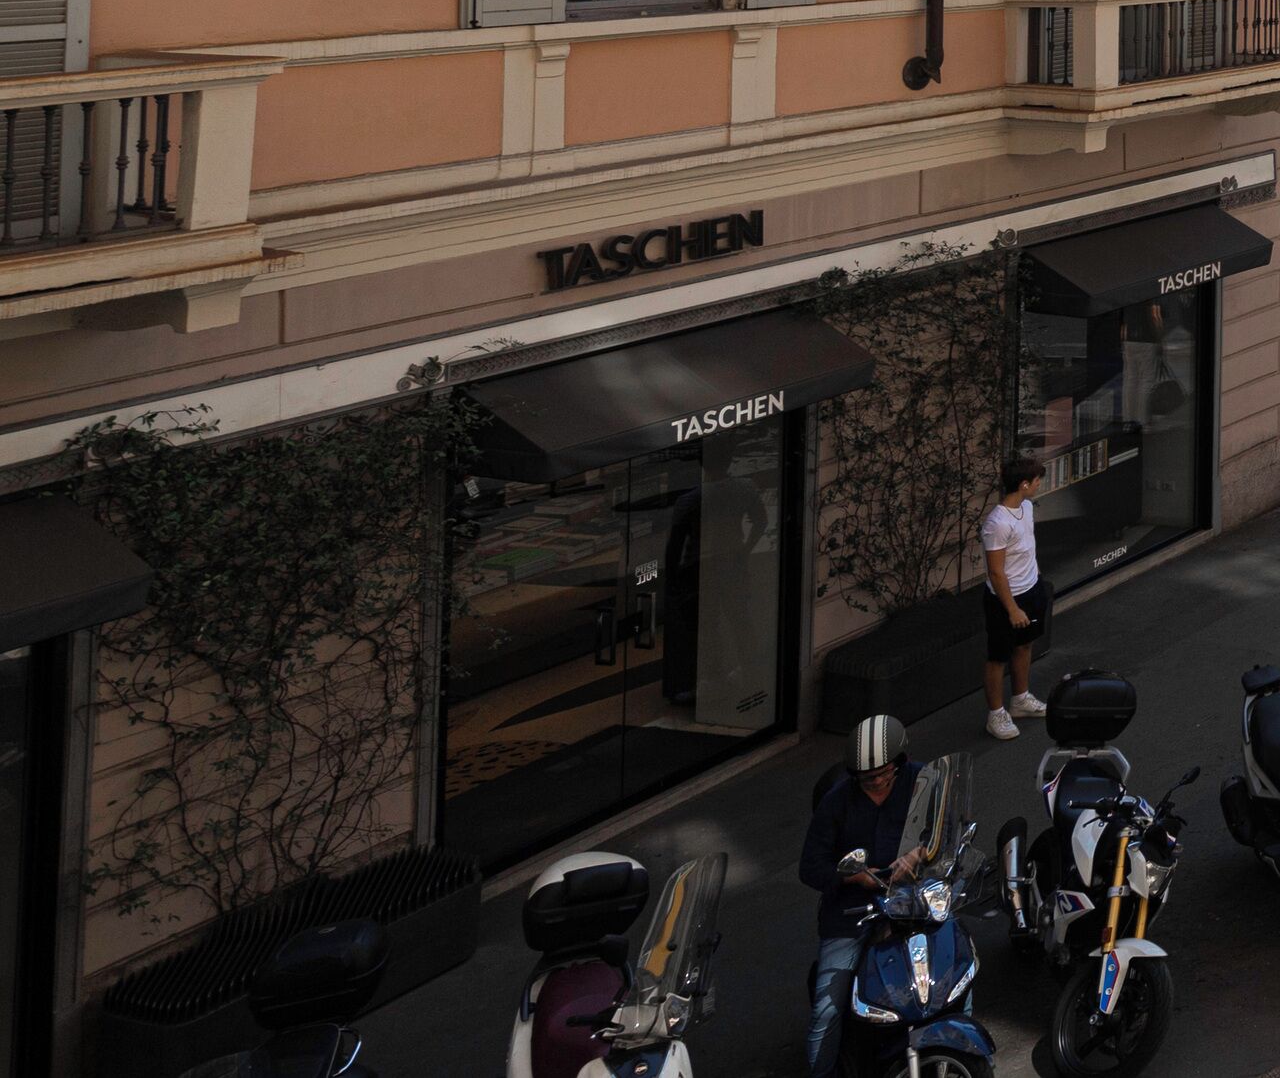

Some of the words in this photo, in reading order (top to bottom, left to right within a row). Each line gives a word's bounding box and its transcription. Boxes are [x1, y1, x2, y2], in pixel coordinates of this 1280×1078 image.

[537, 210, 763, 292] TASCHEN
[1158, 262, 1221, 294] TASCHEN
[671, 391, 784, 442] TASCHEN
[1093, 546, 1128, 568] TASCHEN
